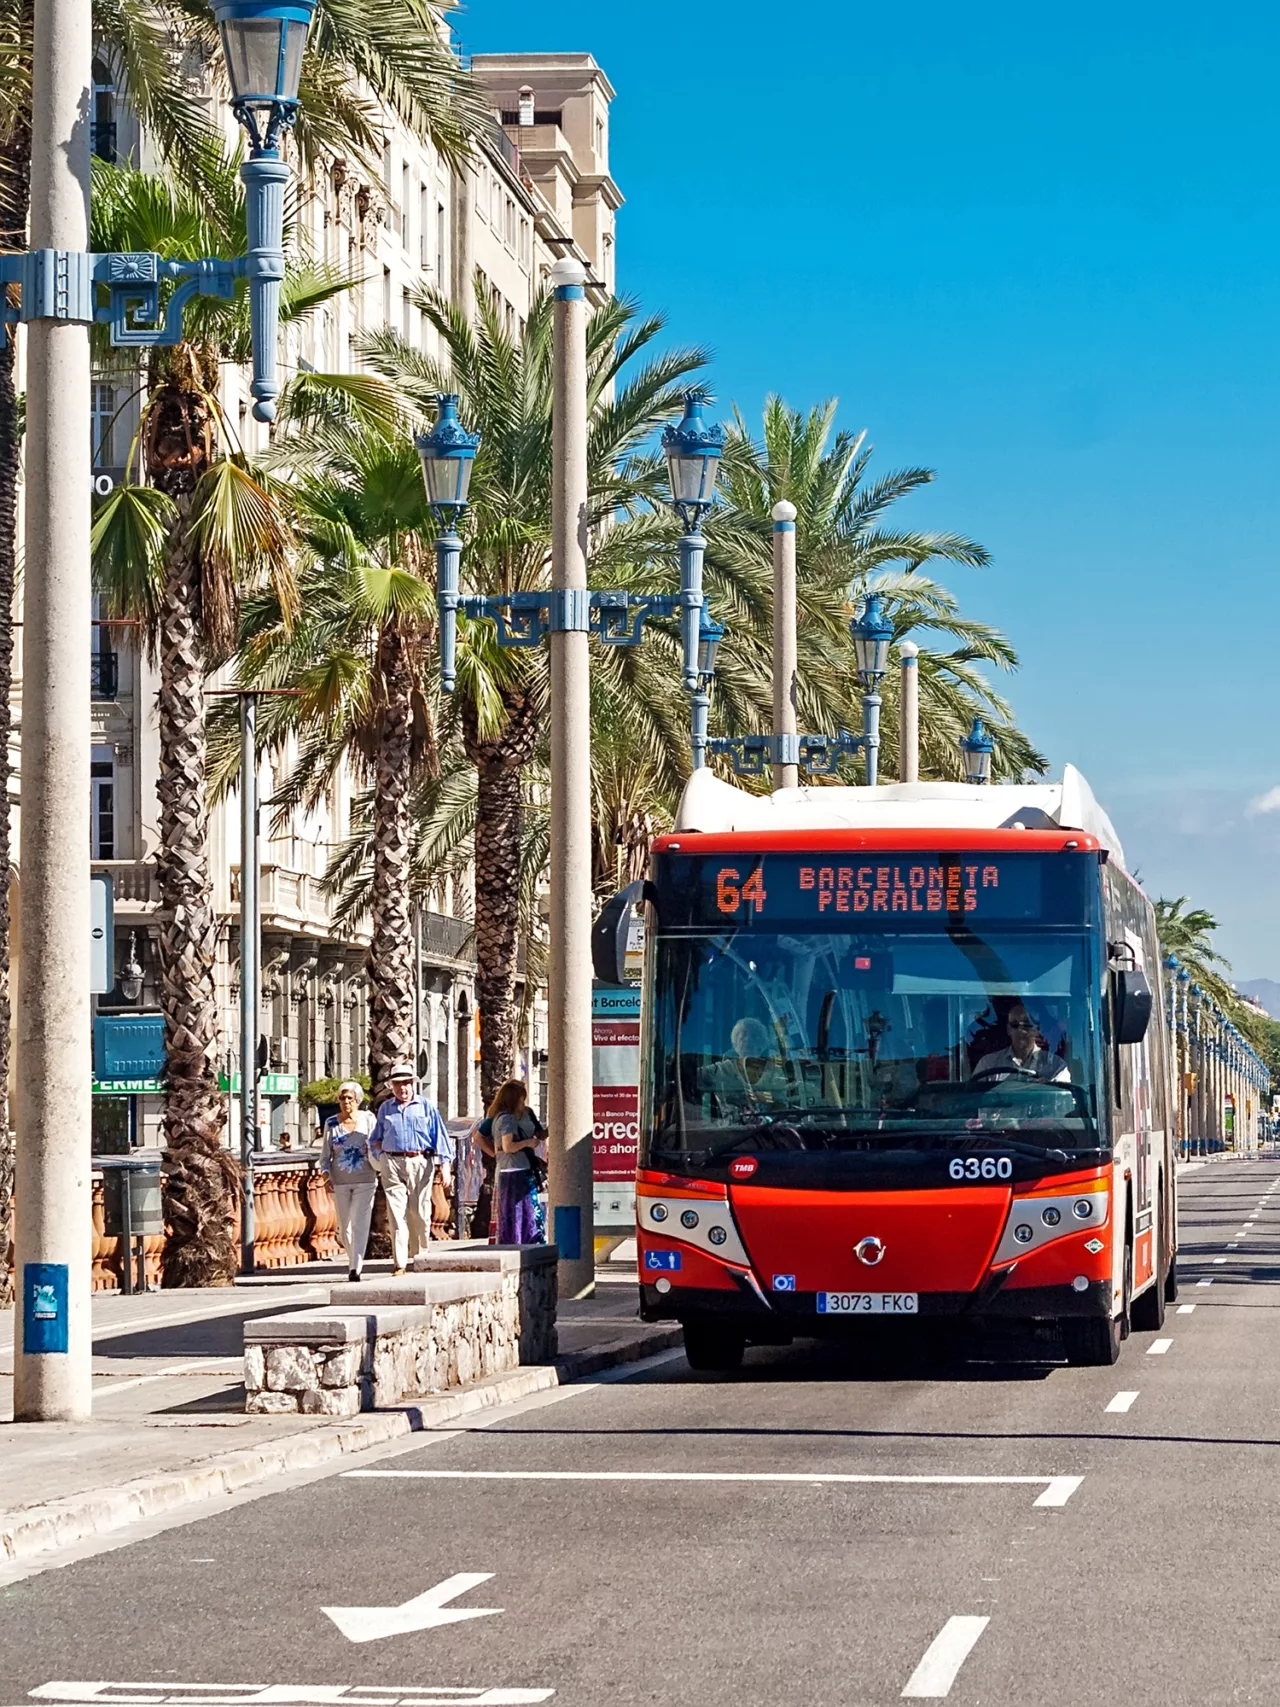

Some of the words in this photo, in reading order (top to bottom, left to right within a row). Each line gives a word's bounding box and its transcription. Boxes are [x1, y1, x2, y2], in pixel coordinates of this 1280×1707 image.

[799, 866, 999, 889] BARCELONETA
[717, 868, 767, 912] 64
[818, 890, 978, 911] PEDRALBES
[734, 1164, 754, 1172] TMB
[949, 1157, 1012, 1179] 6360
[830, 1295, 873, 1311] 3073
[881, 1295, 915, 1311] FKC
